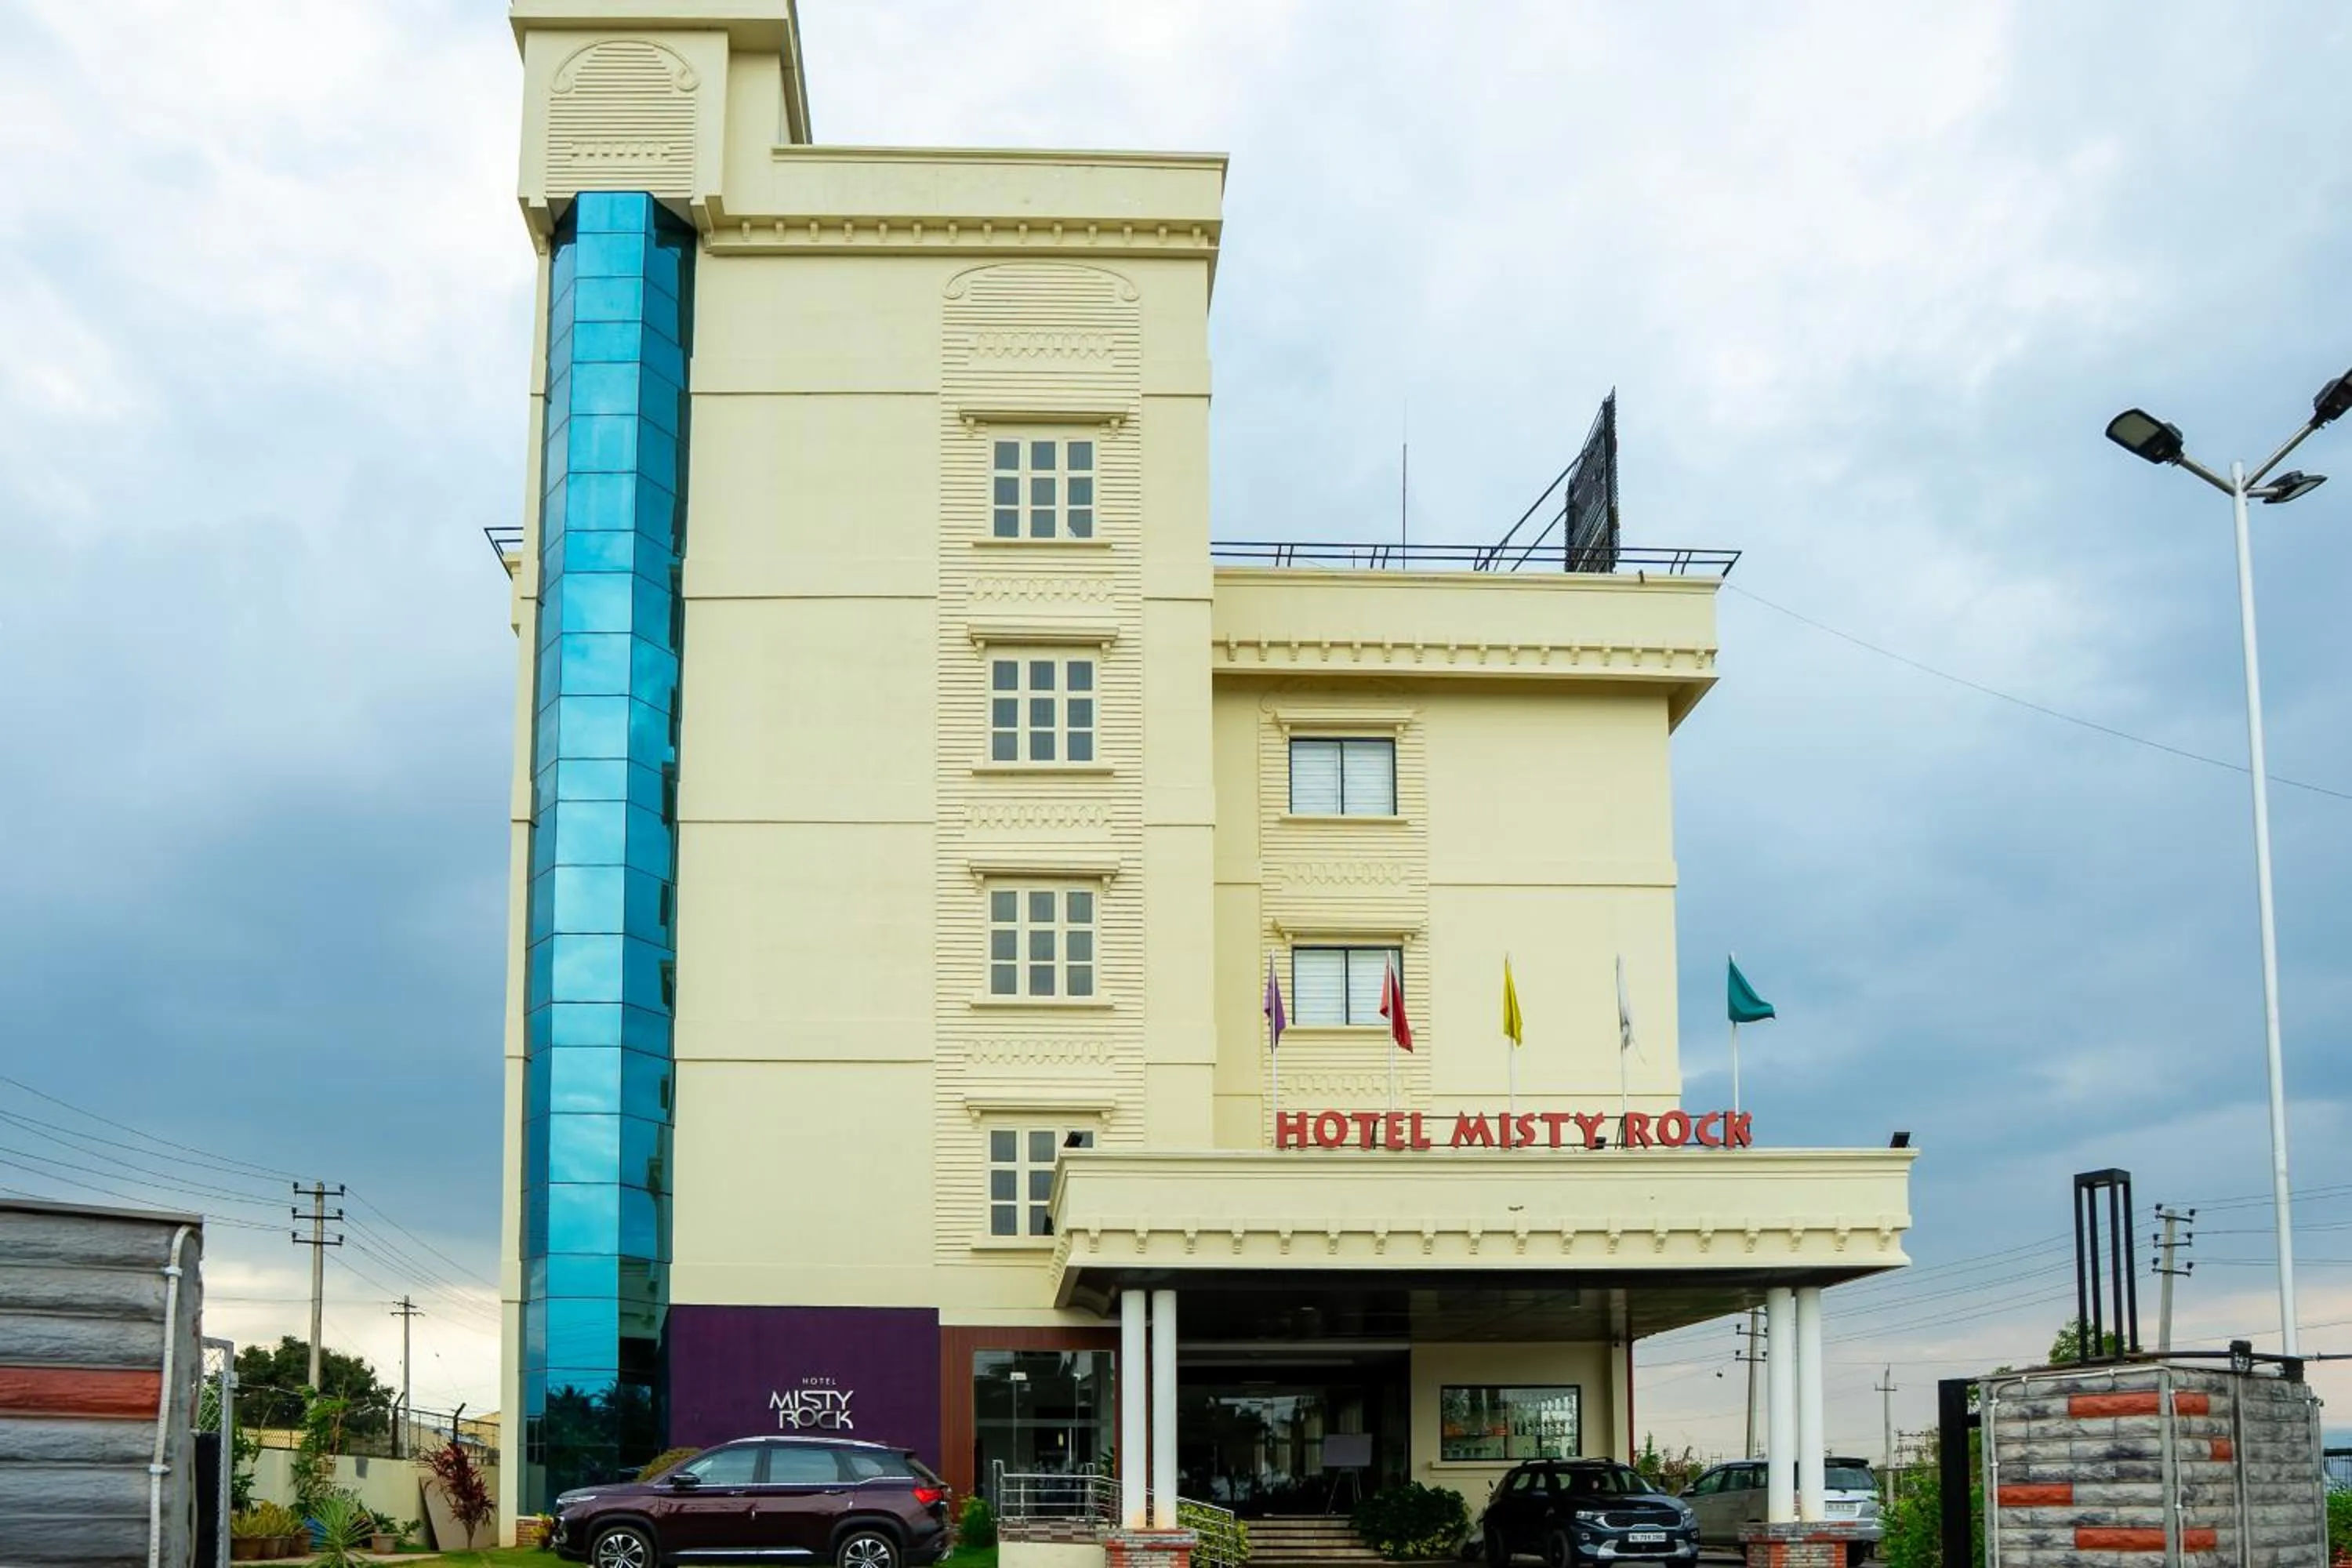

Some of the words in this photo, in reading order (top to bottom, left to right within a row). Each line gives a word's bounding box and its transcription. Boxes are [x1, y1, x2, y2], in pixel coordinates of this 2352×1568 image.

[1276, 1111, 1430, 1149] HOTEL
[1450, 1110, 1605, 1149] MISTY
[1624, 1110, 1753, 1149] ROCK
[769, 1390, 854, 1410] MISTY
[779, 1406, 854, 1429] ROCK
